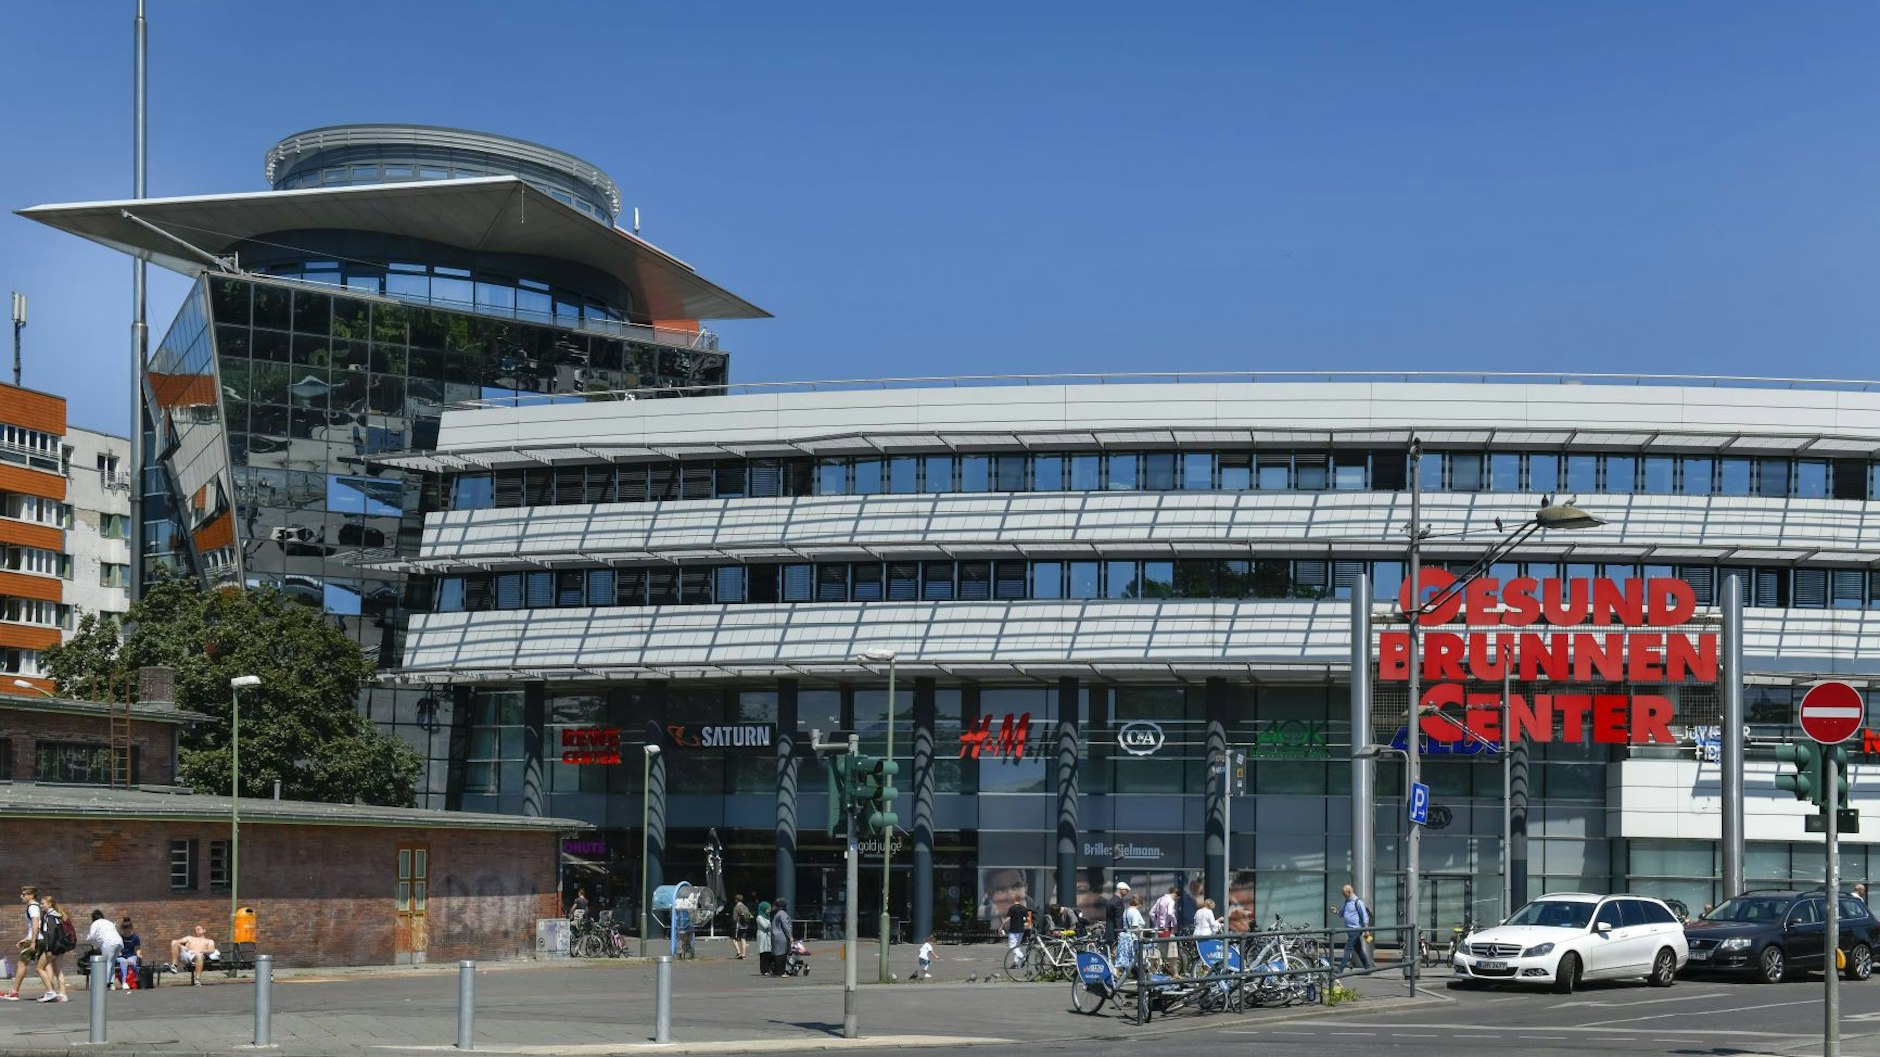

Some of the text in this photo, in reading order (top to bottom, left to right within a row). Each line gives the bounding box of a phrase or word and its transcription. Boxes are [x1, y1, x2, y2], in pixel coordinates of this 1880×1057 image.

[1400, 568, 1697, 627] GESUND
[1379, 632, 1717, 682] BRUNNEN
[1419, 682, 1677, 744] CENTER
[702, 726, 770, 747] SATURN
[960, 712, 1031, 760] H&M
[1126, 729, 1156, 746] C&A
[565, 841, 607, 853] ONUTS
[858, 839, 902, 855] goldjuge
